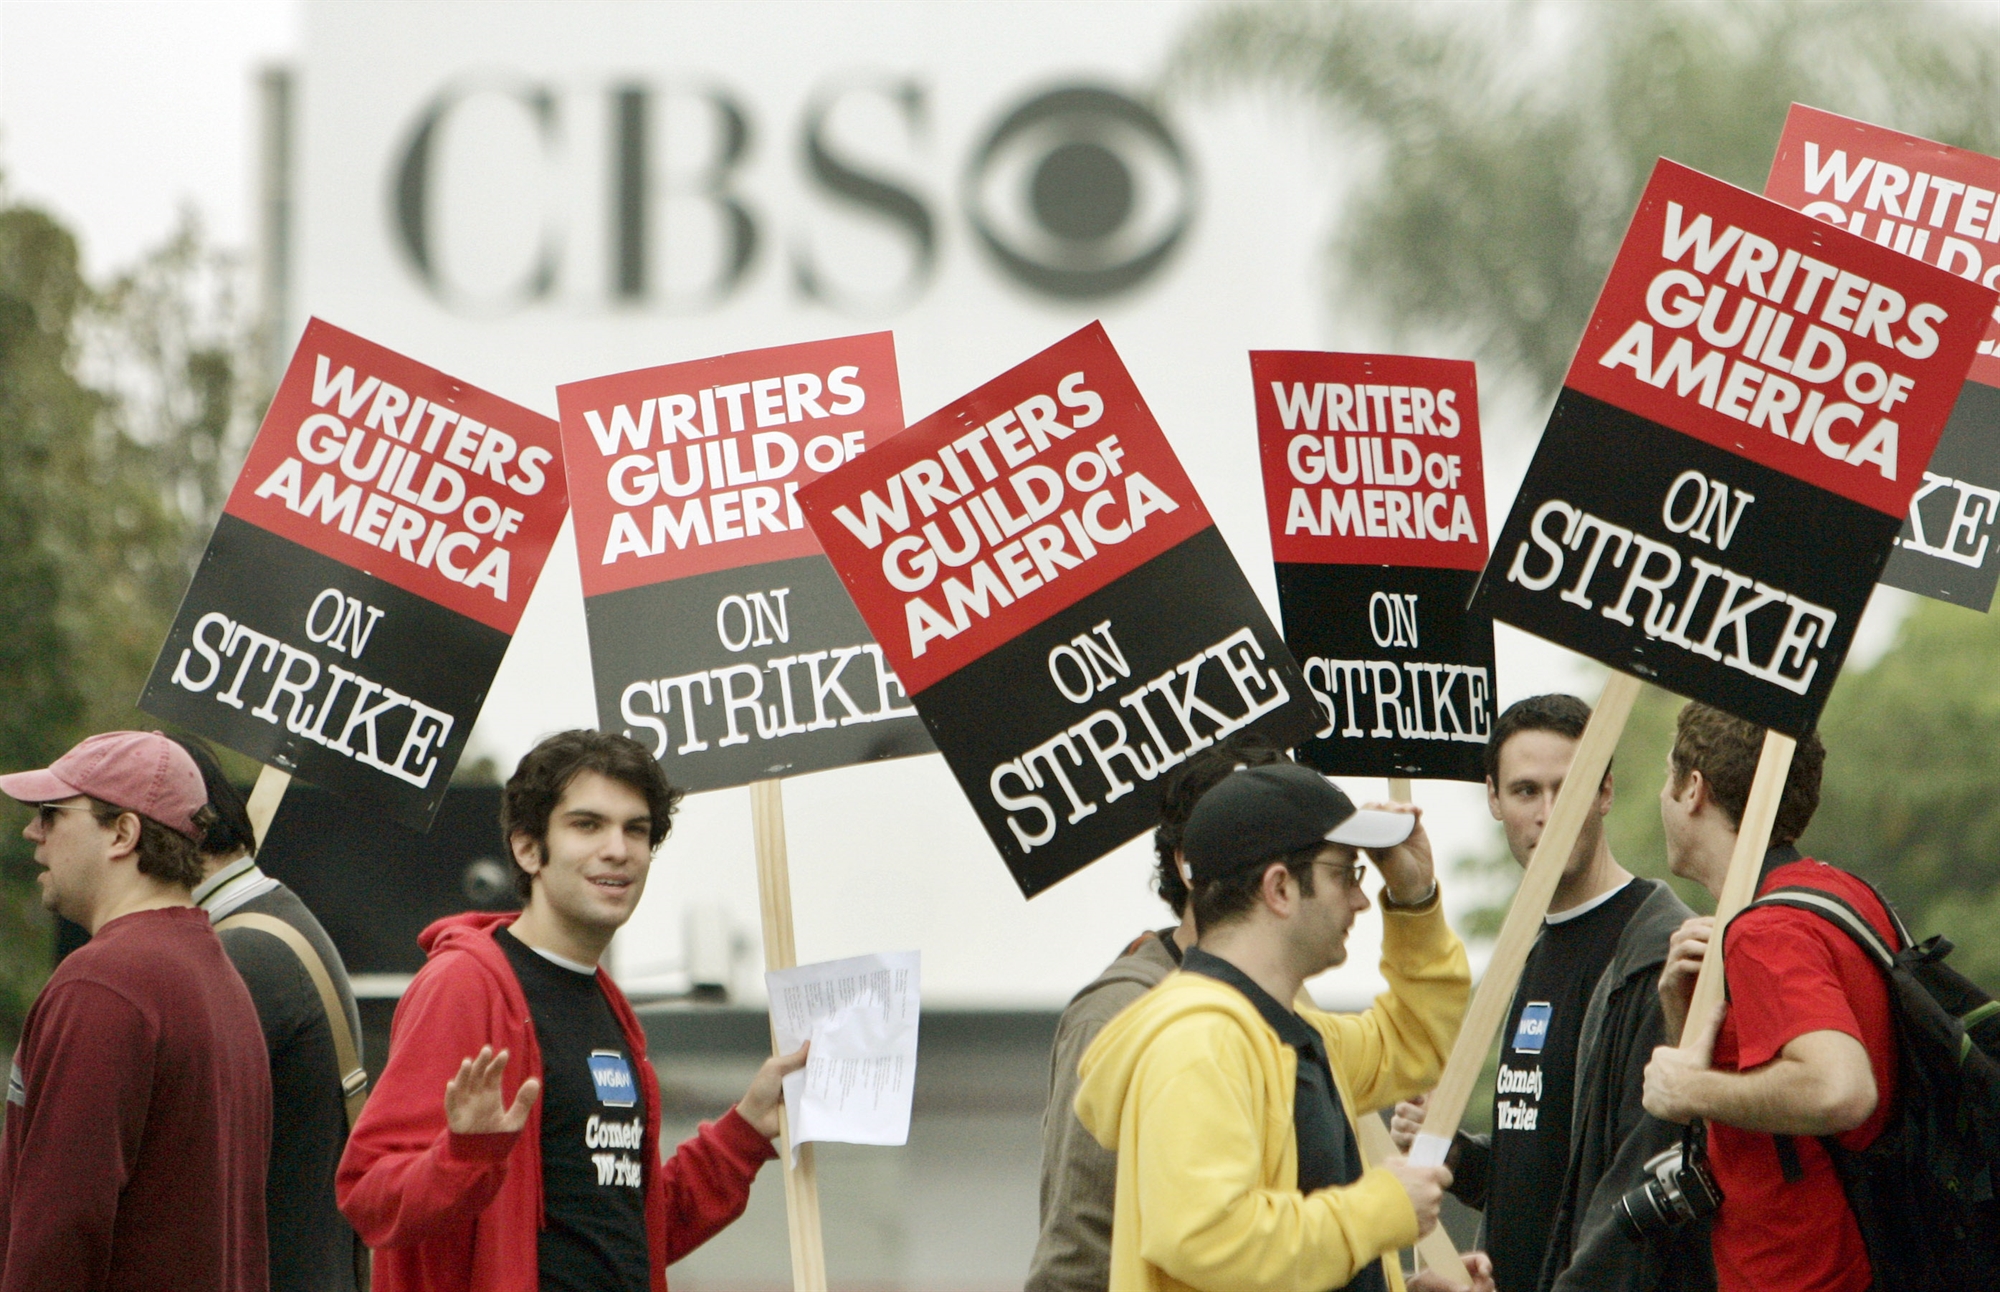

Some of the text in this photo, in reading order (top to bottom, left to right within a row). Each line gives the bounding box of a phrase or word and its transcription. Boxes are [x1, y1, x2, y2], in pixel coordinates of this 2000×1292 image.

[384, 70, 943, 316] CBS
[1804, 141, 2000, 243] WRITE
[1660, 200, 1948, 360] WRITERS
[1645, 269, 1915, 412] GUILD OF
[309, 353, 553, 496] WRITERS
[583, 365, 866, 457] WRITERS
[1271, 381, 1461, 439] WRITERS
[1598, 321, 1900, 482] AMERICA
[297, 413, 525, 541] GUILD OF
[606, 430, 865, 507] GUILD OF
[832, 371, 1104, 550] WRITERS
[1287, 434, 1461, 490] GUILD OF
[1662, 470, 1755, 551] ON
[254, 457, 511, 602] AMERICA
[601, 482, 804, 565] AMERI
[881, 434, 1126, 592] GUILD OF
[1284, 488, 1478, 544] AMERICA
[904, 471, 1180, 659] AMERICA
[1506, 500, 1837, 696] STRIKE
[305, 588, 385, 659] ON
[716, 588, 790, 652] ON
[1048, 619, 1131, 704] ON
[1369, 591, 1418, 649] ON
[171, 612, 454, 789] STRIKE
[989, 627, 1290, 854] STRIKE
[1302, 656, 1491, 744] STRIKE
[1498, 1099, 1538, 1131] Writer
